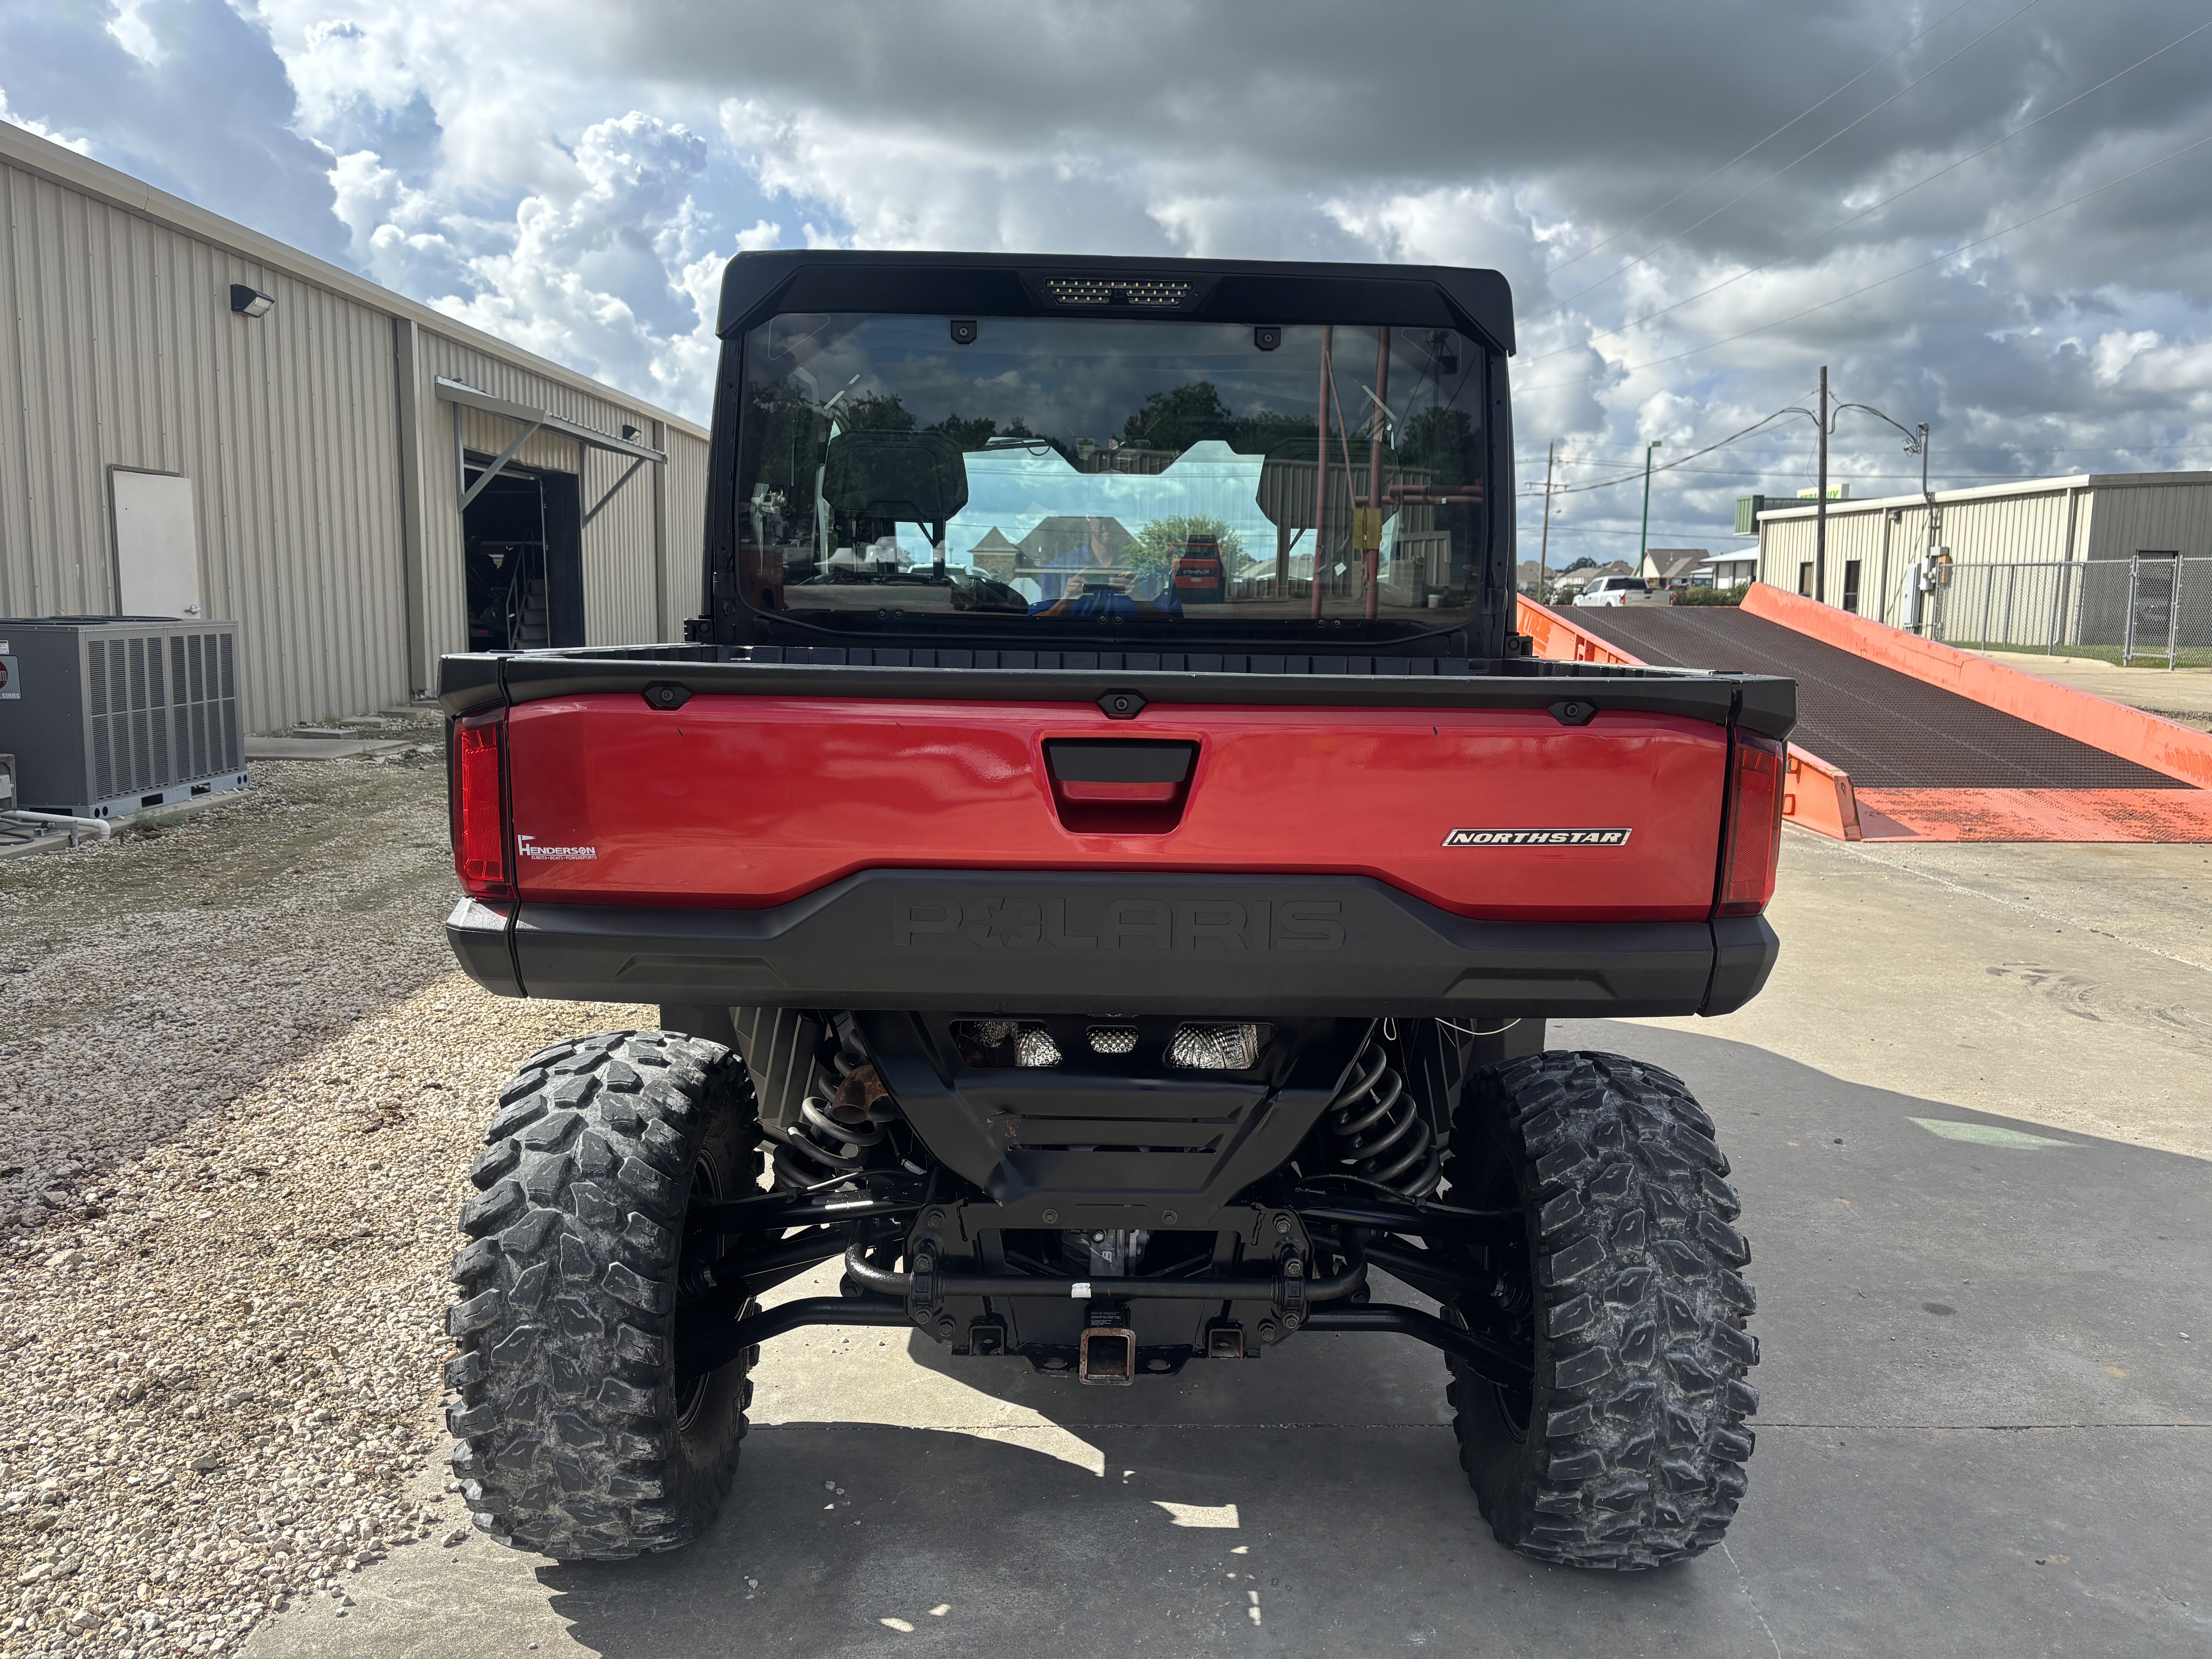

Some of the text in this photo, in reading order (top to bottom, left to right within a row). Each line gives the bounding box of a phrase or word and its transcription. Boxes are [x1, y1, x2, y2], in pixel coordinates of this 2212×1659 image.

[517, 835, 596, 855] HENDERSON
[1453, 832, 1622, 843] NORTHSTAR
[893, 896, 1346, 952] POLARIS
